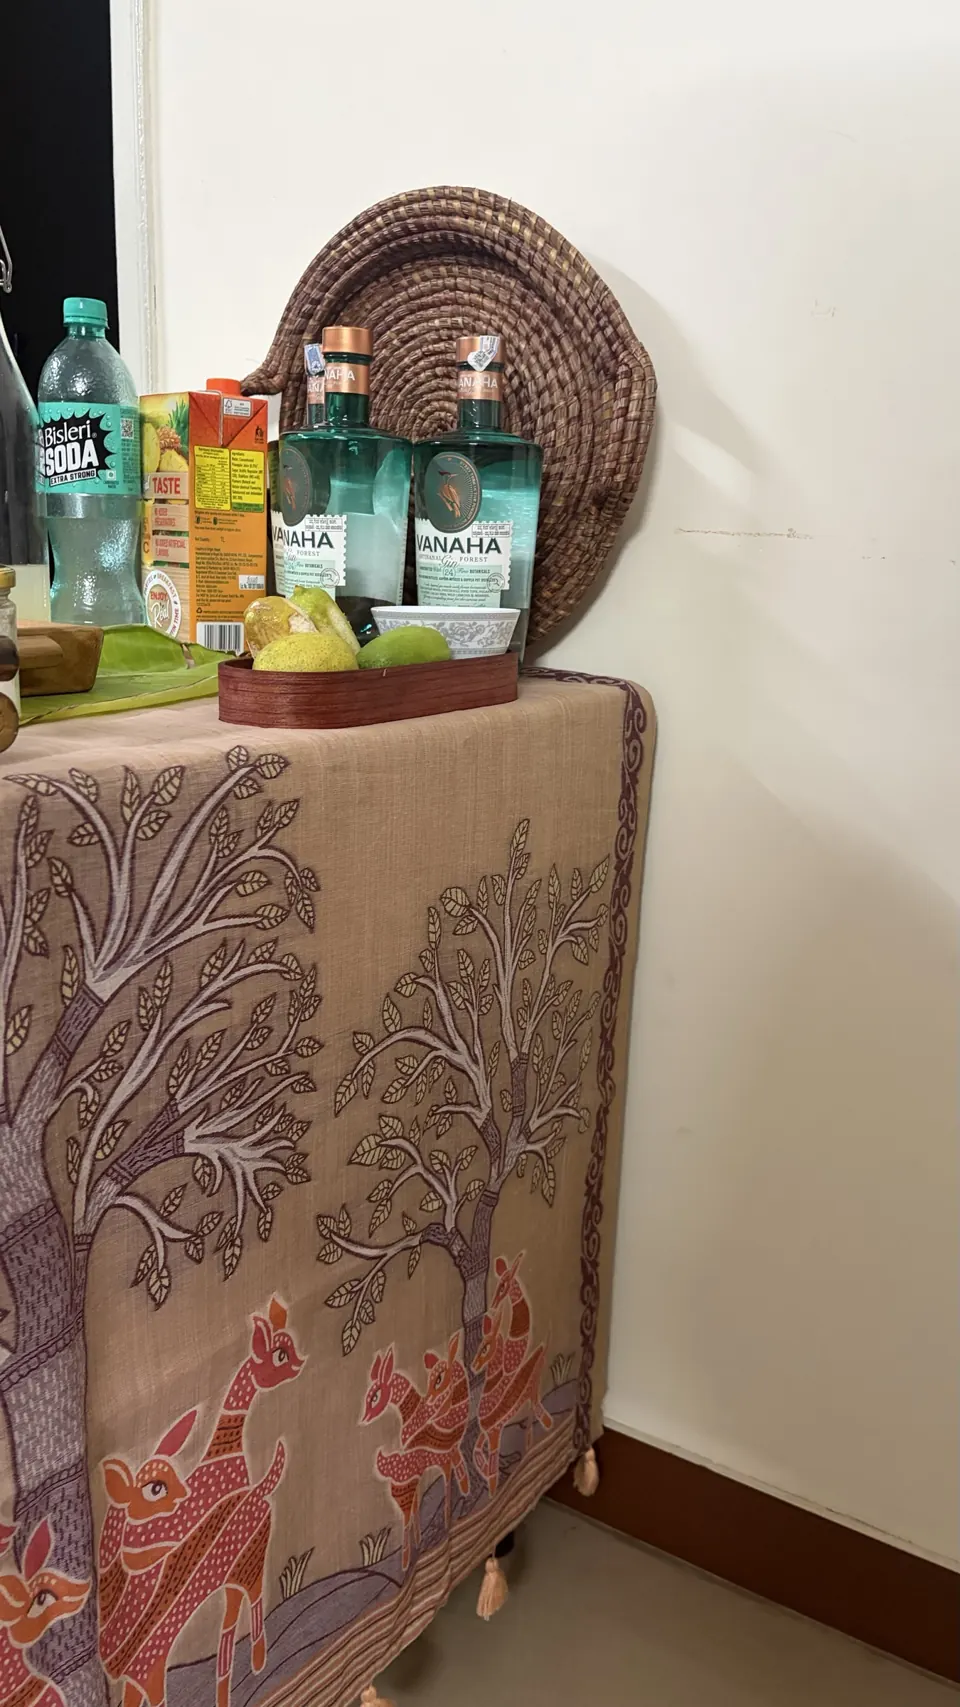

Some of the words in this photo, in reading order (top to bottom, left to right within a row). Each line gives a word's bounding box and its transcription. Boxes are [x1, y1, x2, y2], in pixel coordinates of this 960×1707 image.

[44, 419, 91, 447] Bisleri
[45, 438, 100, 477] SODA
[50, 474, 69, 485] EXTRA
[69, 469, 96, 481] STRONG
[152, 477, 182, 495] TASTE
[416, 534, 502, 554] VANAHA
[150, 591, 168, 601] ENJOY
